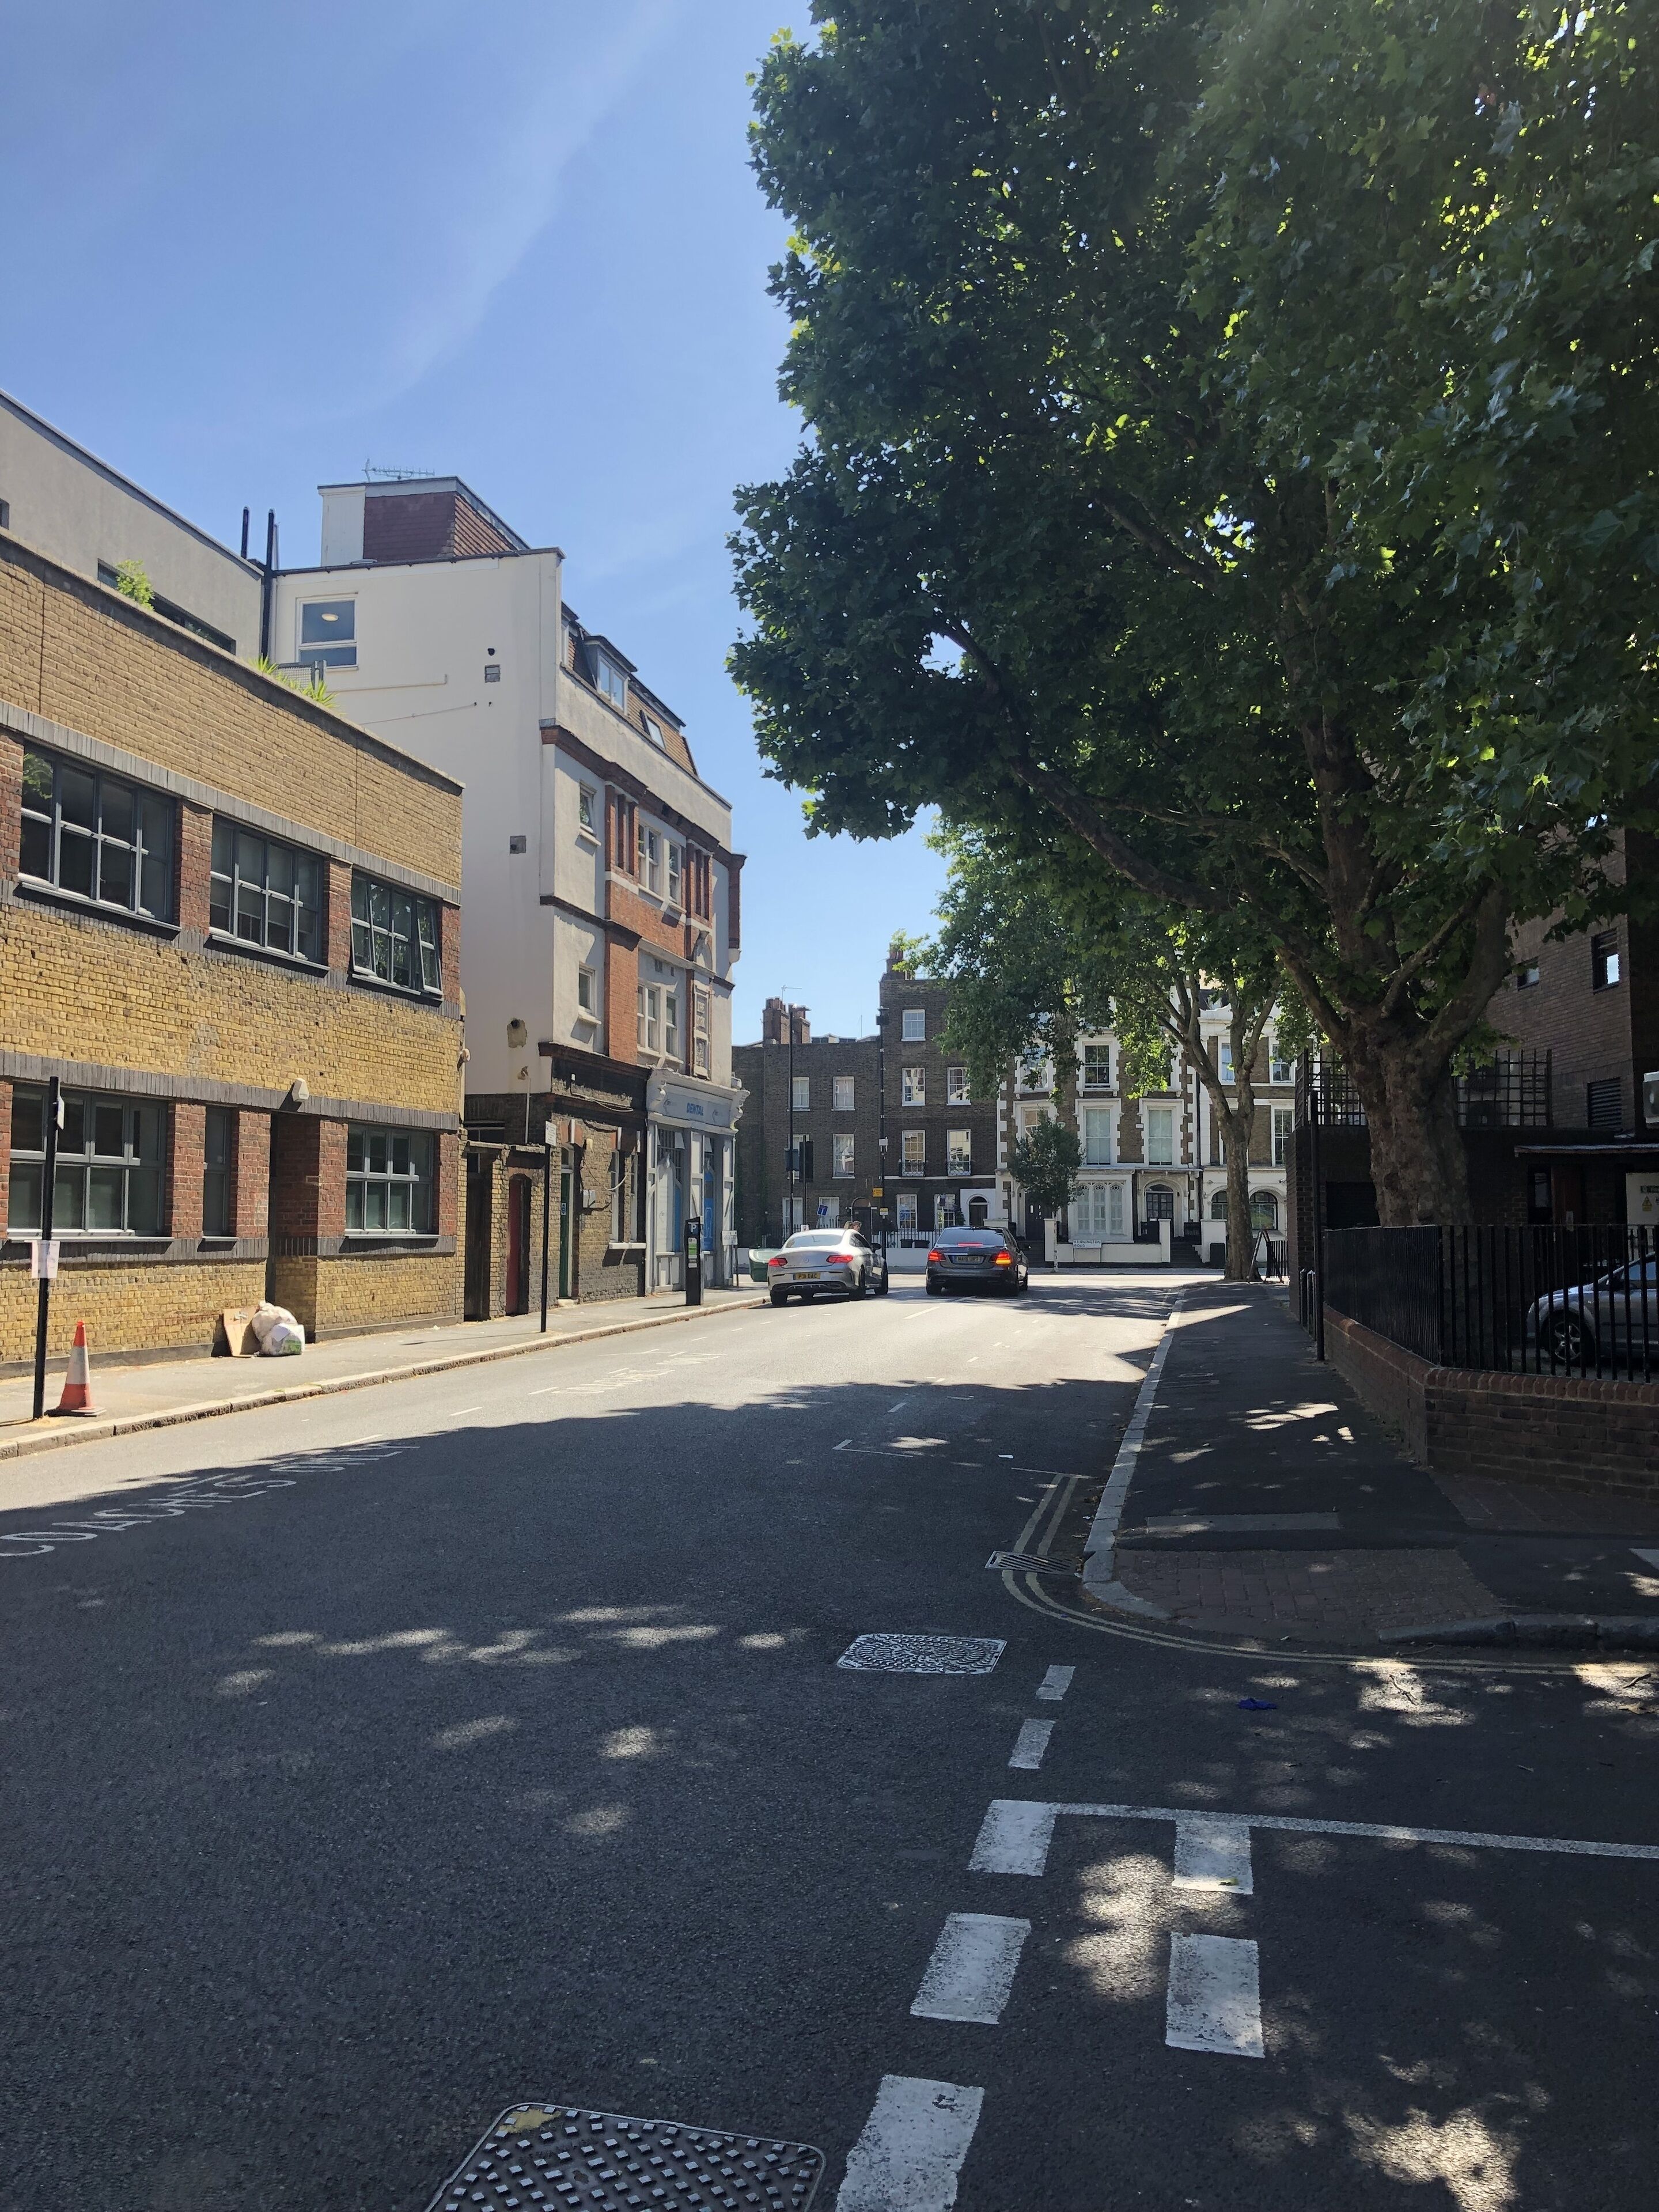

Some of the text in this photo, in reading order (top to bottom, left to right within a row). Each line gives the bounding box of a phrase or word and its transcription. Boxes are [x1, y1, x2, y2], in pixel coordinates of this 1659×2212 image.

[686, 1102, 704, 1116] DENTAL
[691, 1224, 697, 1233] P
[269, 1442, 421, 1473] ONLY
